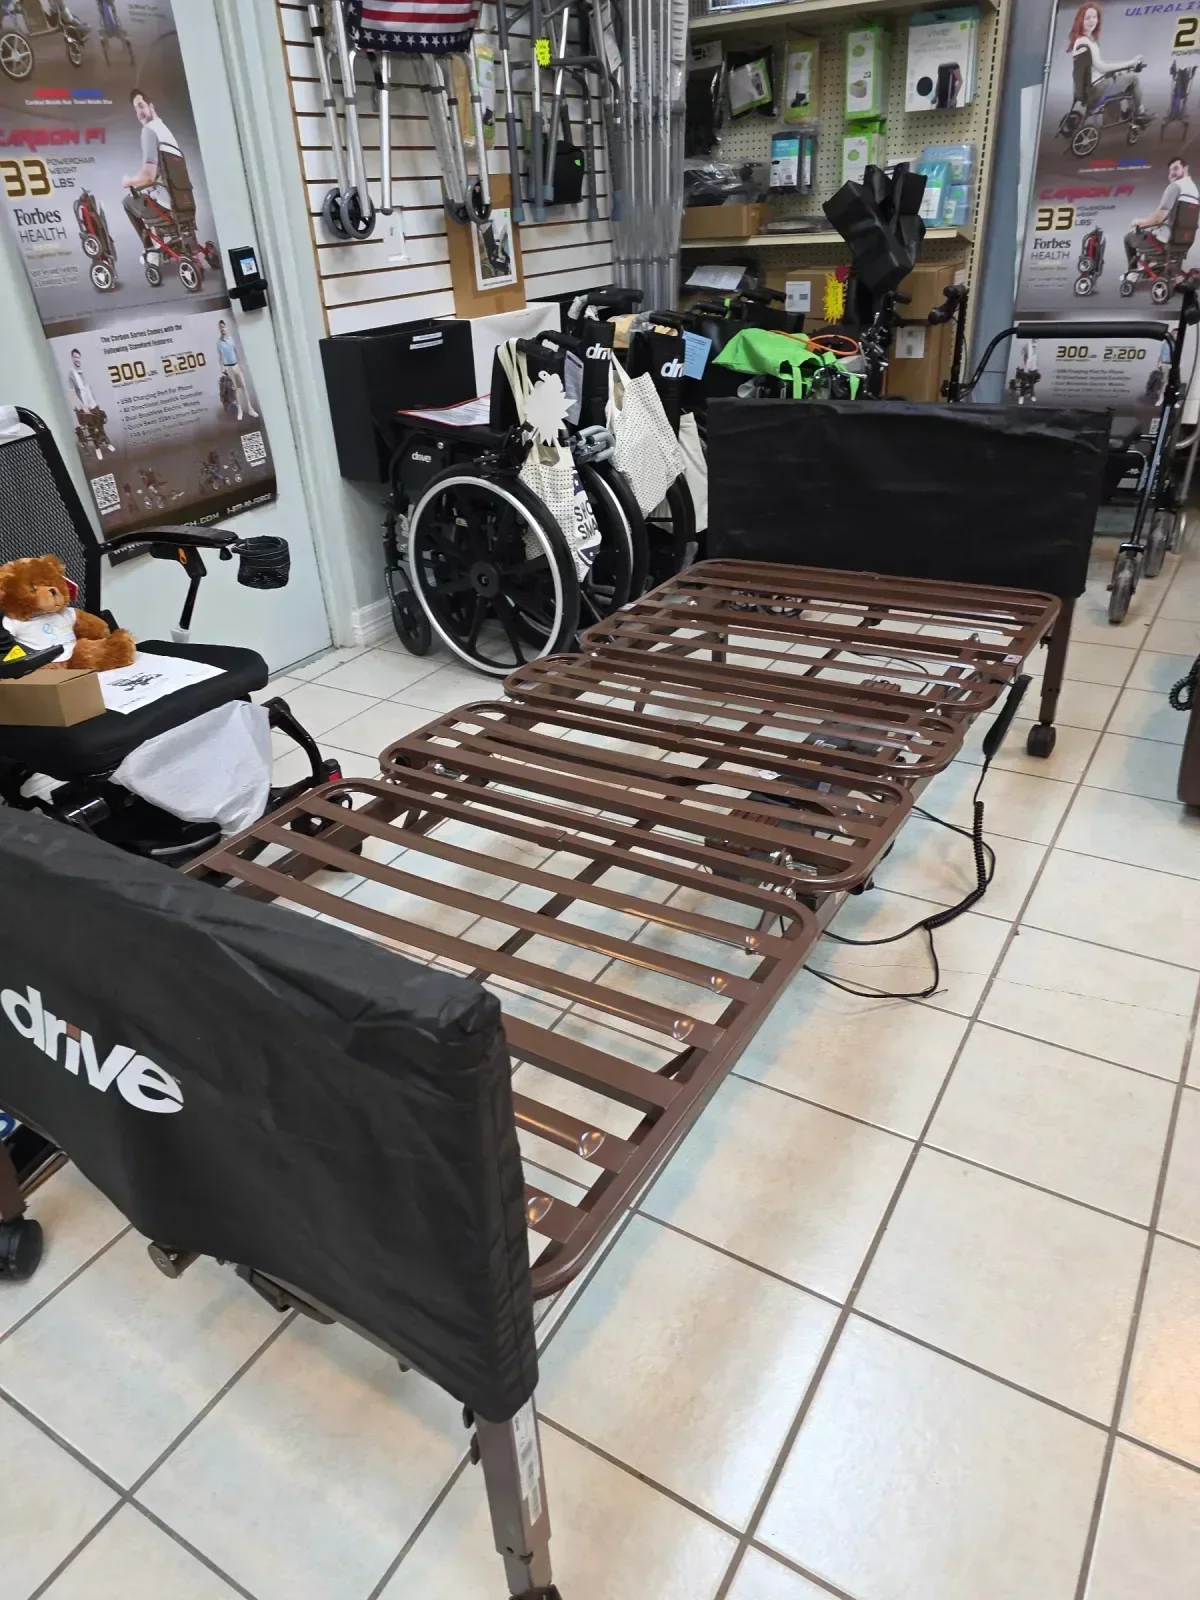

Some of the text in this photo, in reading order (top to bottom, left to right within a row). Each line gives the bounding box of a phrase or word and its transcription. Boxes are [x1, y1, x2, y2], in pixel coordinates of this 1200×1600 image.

[1125, 2, 1200, 16] ULTRALI
[1174, 17, 1200, 48] 2
[46, 156, 95, 166] POWERCHAIR
[0, 159, 51, 197] 33
[49, 167, 77, 175] WEIGHT
[13, 207, 62, 226] Forbes
[1036, 207, 1075, 231] 33
[18, 226, 67, 243] HEALTH
[1033, 237, 1072, 249] Forbes
[1030, 251, 1071, 260] HEALTH
[1056, 345, 1089, 358] 300
[107, 360, 147, 383] 300
[161, 352, 206, 374] 2x200
[411, 451, 432, 463] drive
[573, 499, 594, 522] SHO
[181, 512, 220, 528] CH.COM
[577, 517, 599, 540] SMA
[0, 985, 185, 1114] drive
